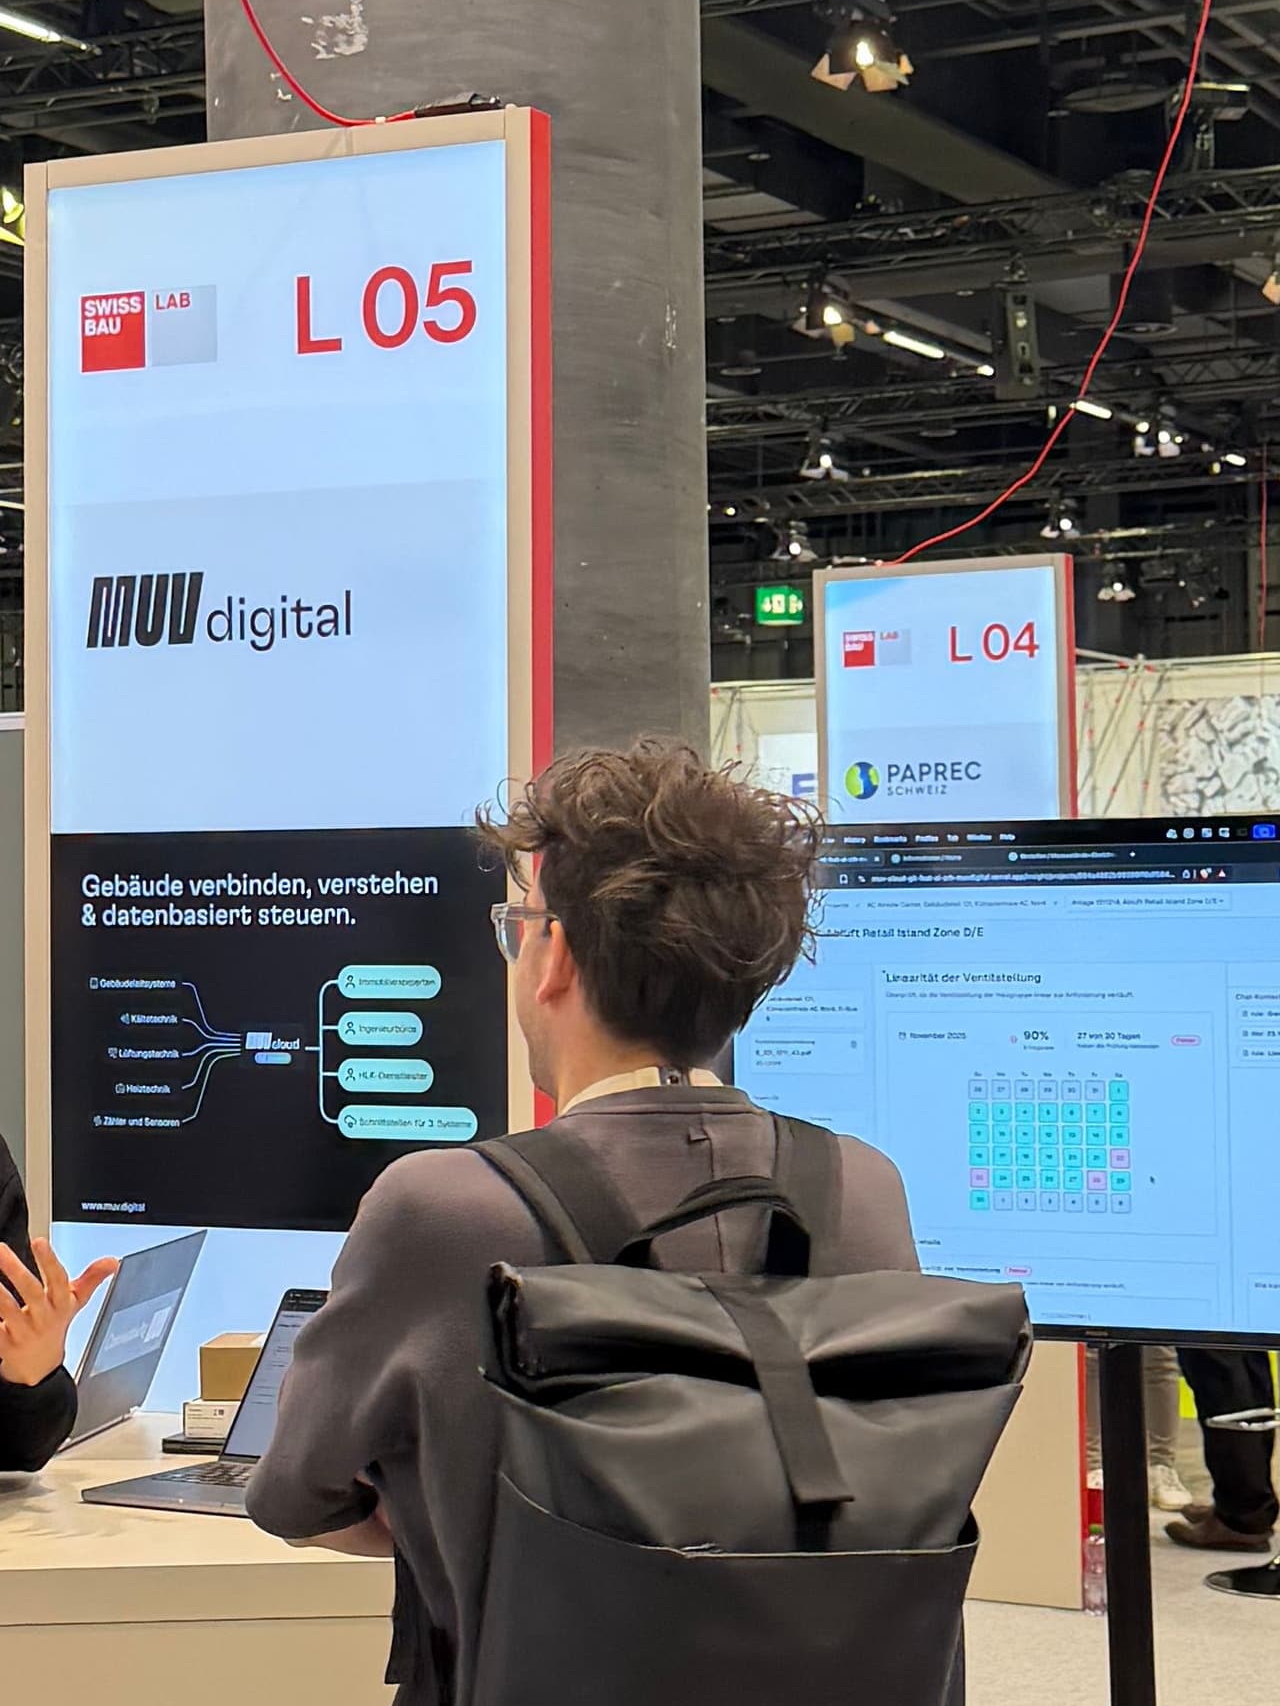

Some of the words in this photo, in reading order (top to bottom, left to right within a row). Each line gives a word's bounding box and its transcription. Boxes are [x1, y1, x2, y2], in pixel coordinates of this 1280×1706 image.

[84, 298, 141, 317] SWISS
[154, 292, 191, 310] LAB
[296, 275, 343, 355] L
[362, 260, 477, 349] 05
[84, 318, 121, 337] BAU
[950, 626, 973, 662] L
[982, 622, 1040, 661] 04
[887, 762, 982, 783] PAPREC
[887, 784, 948, 796] SCHWEIZ
[81, 873, 183, 897] Gebäude
[188, 872, 312, 899] verbinden,
[317, 870, 439, 894] verstehen
[81, 904, 97, 927] &
[102, 904, 252, 926] datenbasiert
[258, 906, 356, 925] steuern.
[933, 927, 961, 938] Zone
[963, 927, 984, 937] D/E
[886, 973, 939, 983] Linearität
[941, 973, 961, 983] der
[1023, 1030, 1049, 1041] 90%
